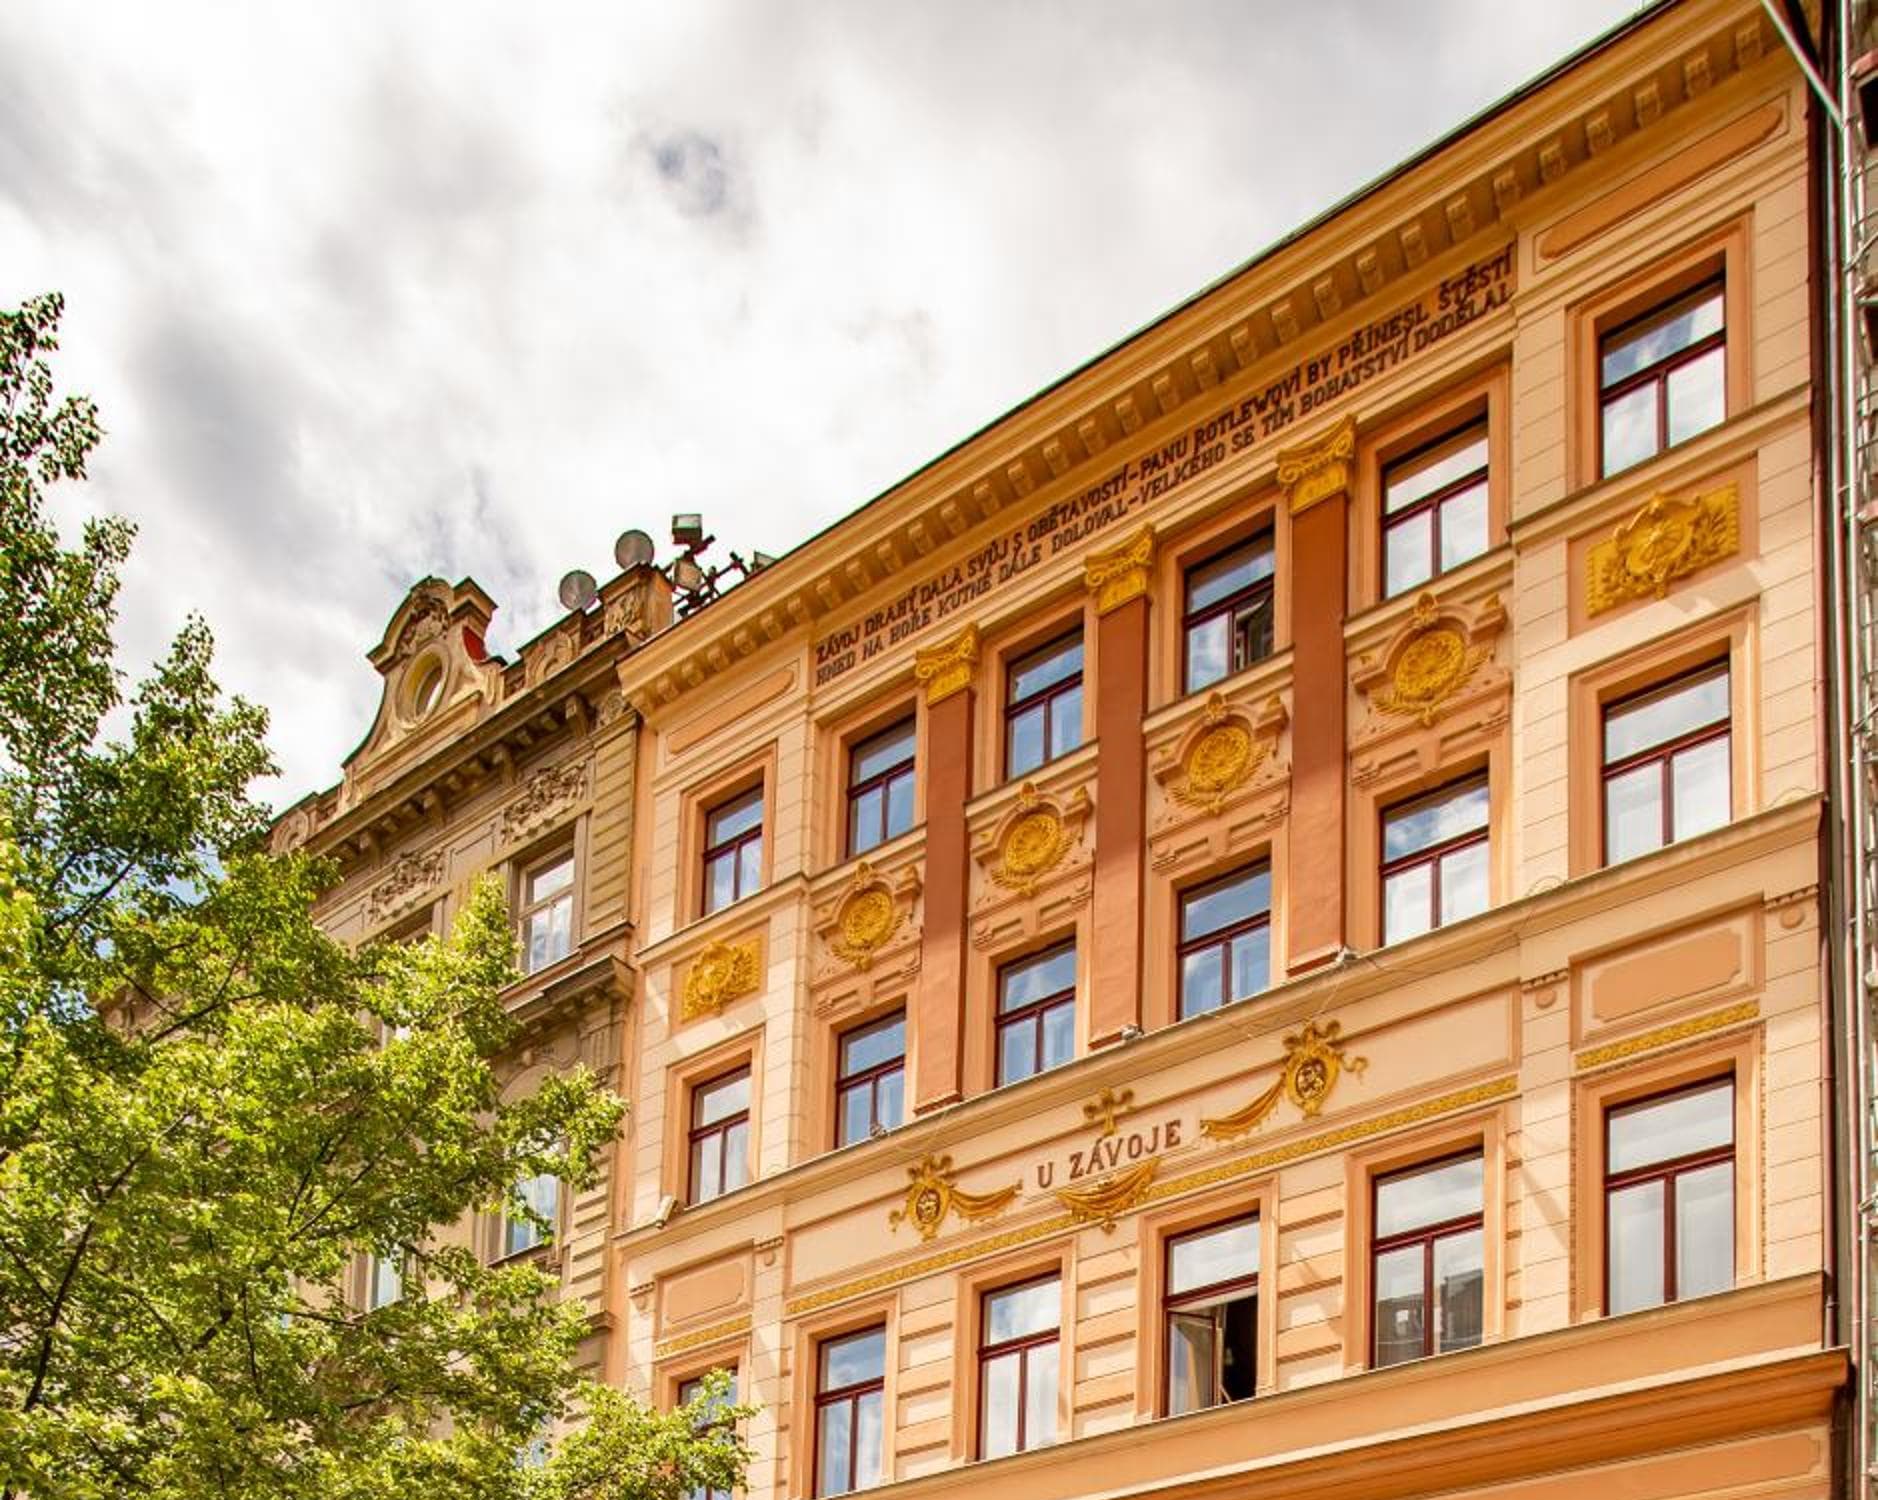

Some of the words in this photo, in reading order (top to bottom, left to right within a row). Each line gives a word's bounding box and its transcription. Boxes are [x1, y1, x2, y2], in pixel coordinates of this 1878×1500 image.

[816, 623, 860, 664] ZÁVOJ
[920, 567, 962, 603] DALA
[1308, 353, 1331, 386] BY
[1438, 242, 1513, 310] ŠTĚSTÍ
[862, 635, 883, 661] NA
[1232, 425, 1254, 453] SE
[1037, 1162, 1054, 1188] U
[1069, 1119, 1181, 1179] ZÁVOJE
